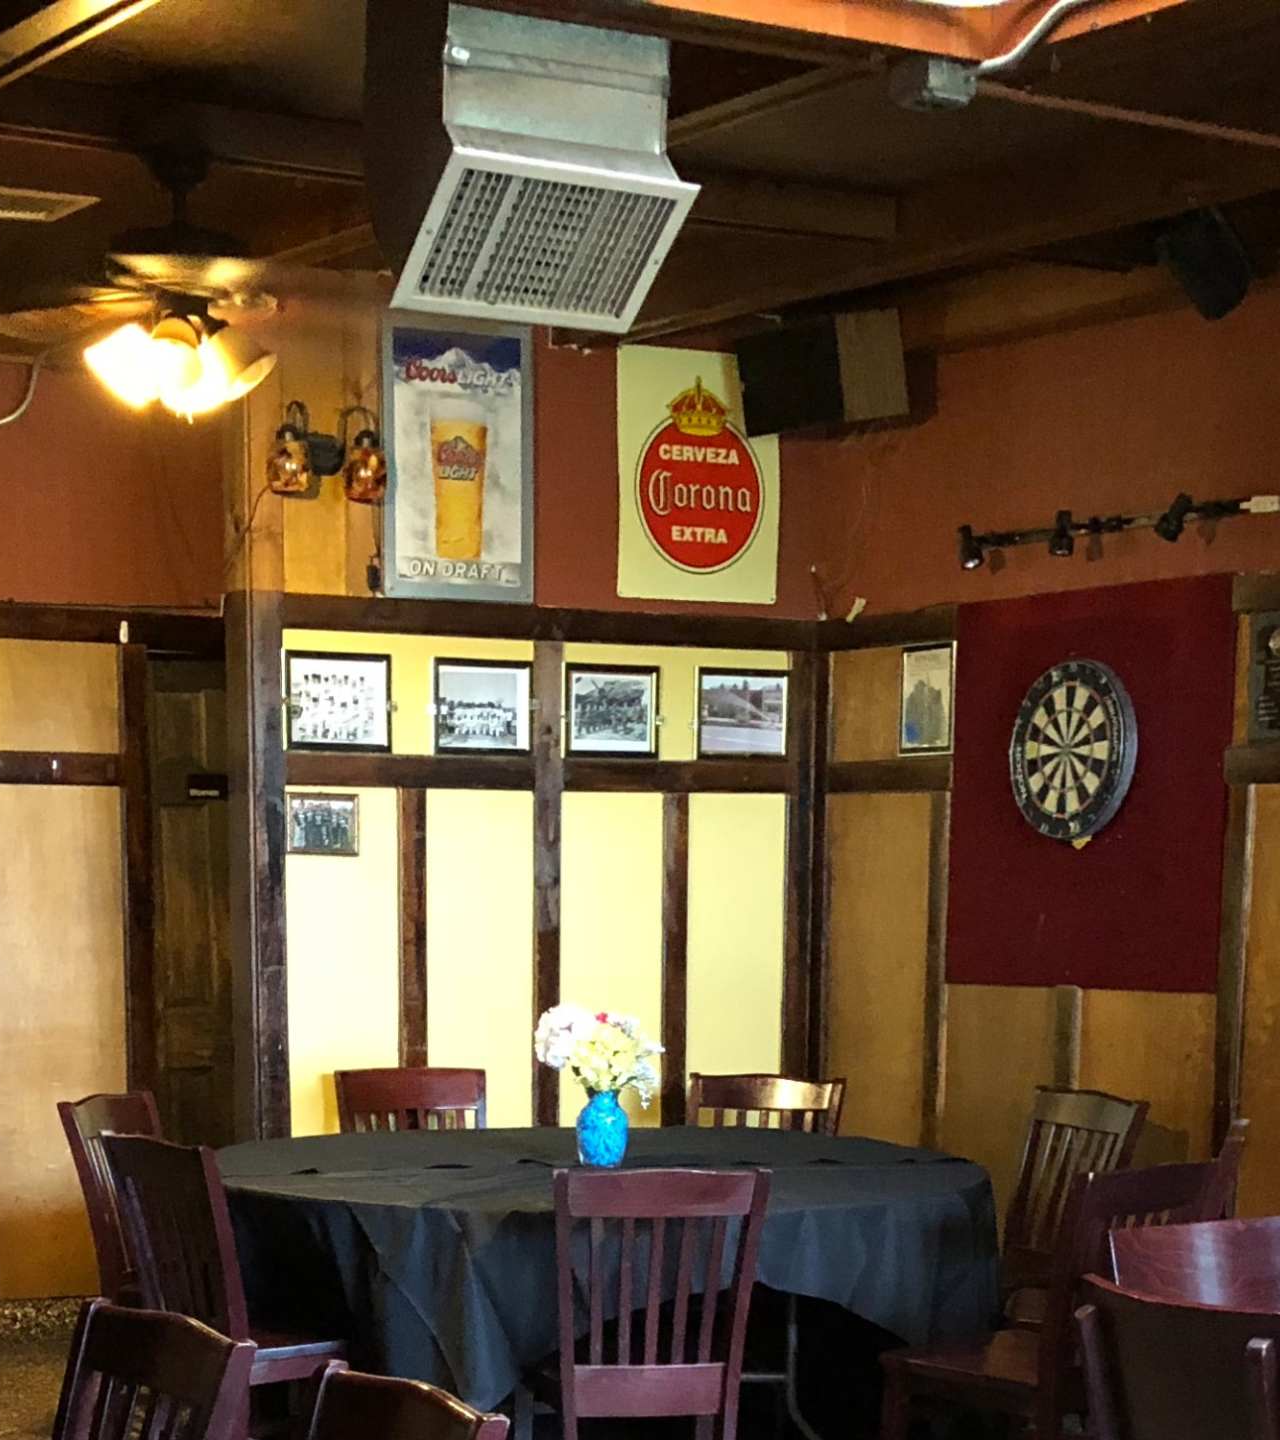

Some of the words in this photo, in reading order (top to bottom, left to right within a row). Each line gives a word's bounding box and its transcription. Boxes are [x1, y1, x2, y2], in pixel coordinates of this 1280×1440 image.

[405, 357, 458, 384] Coors
[658, 443, 740, 465] CERVEZA
[648, 468, 752, 516] Corona
[671, 525, 728, 544] EXTRA
[409, 559, 436, 576] ON
[441, 562, 503, 581] DRAFT
